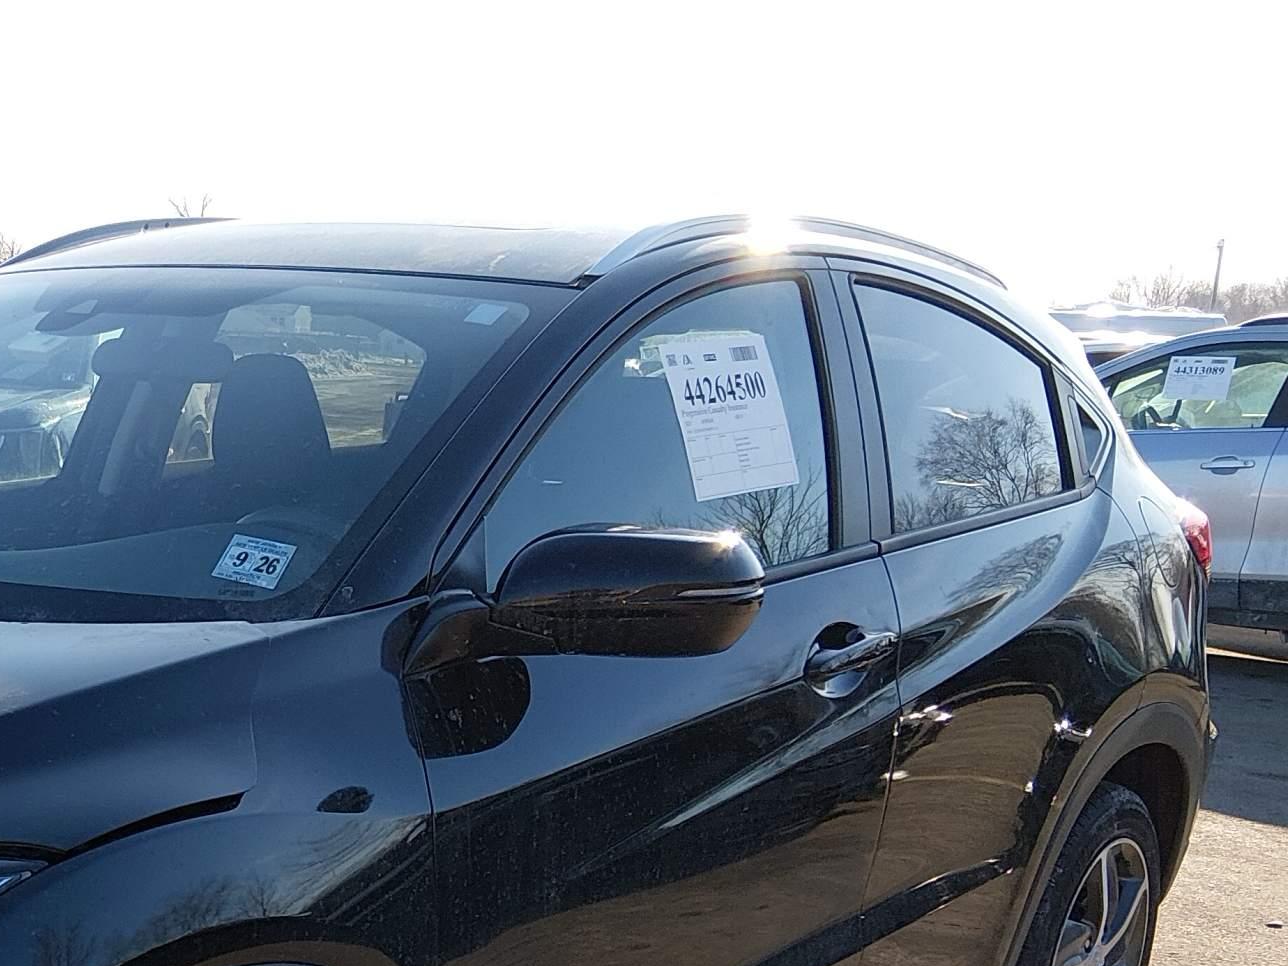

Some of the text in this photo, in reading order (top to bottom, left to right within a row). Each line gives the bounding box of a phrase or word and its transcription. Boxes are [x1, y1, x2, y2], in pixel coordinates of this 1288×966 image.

[1174, 365, 1225, 376] 44313089
[684, 371, 766, 406] 44264500
[232, 551, 249, 567] 9
[253, 555, 281, 576] 26
